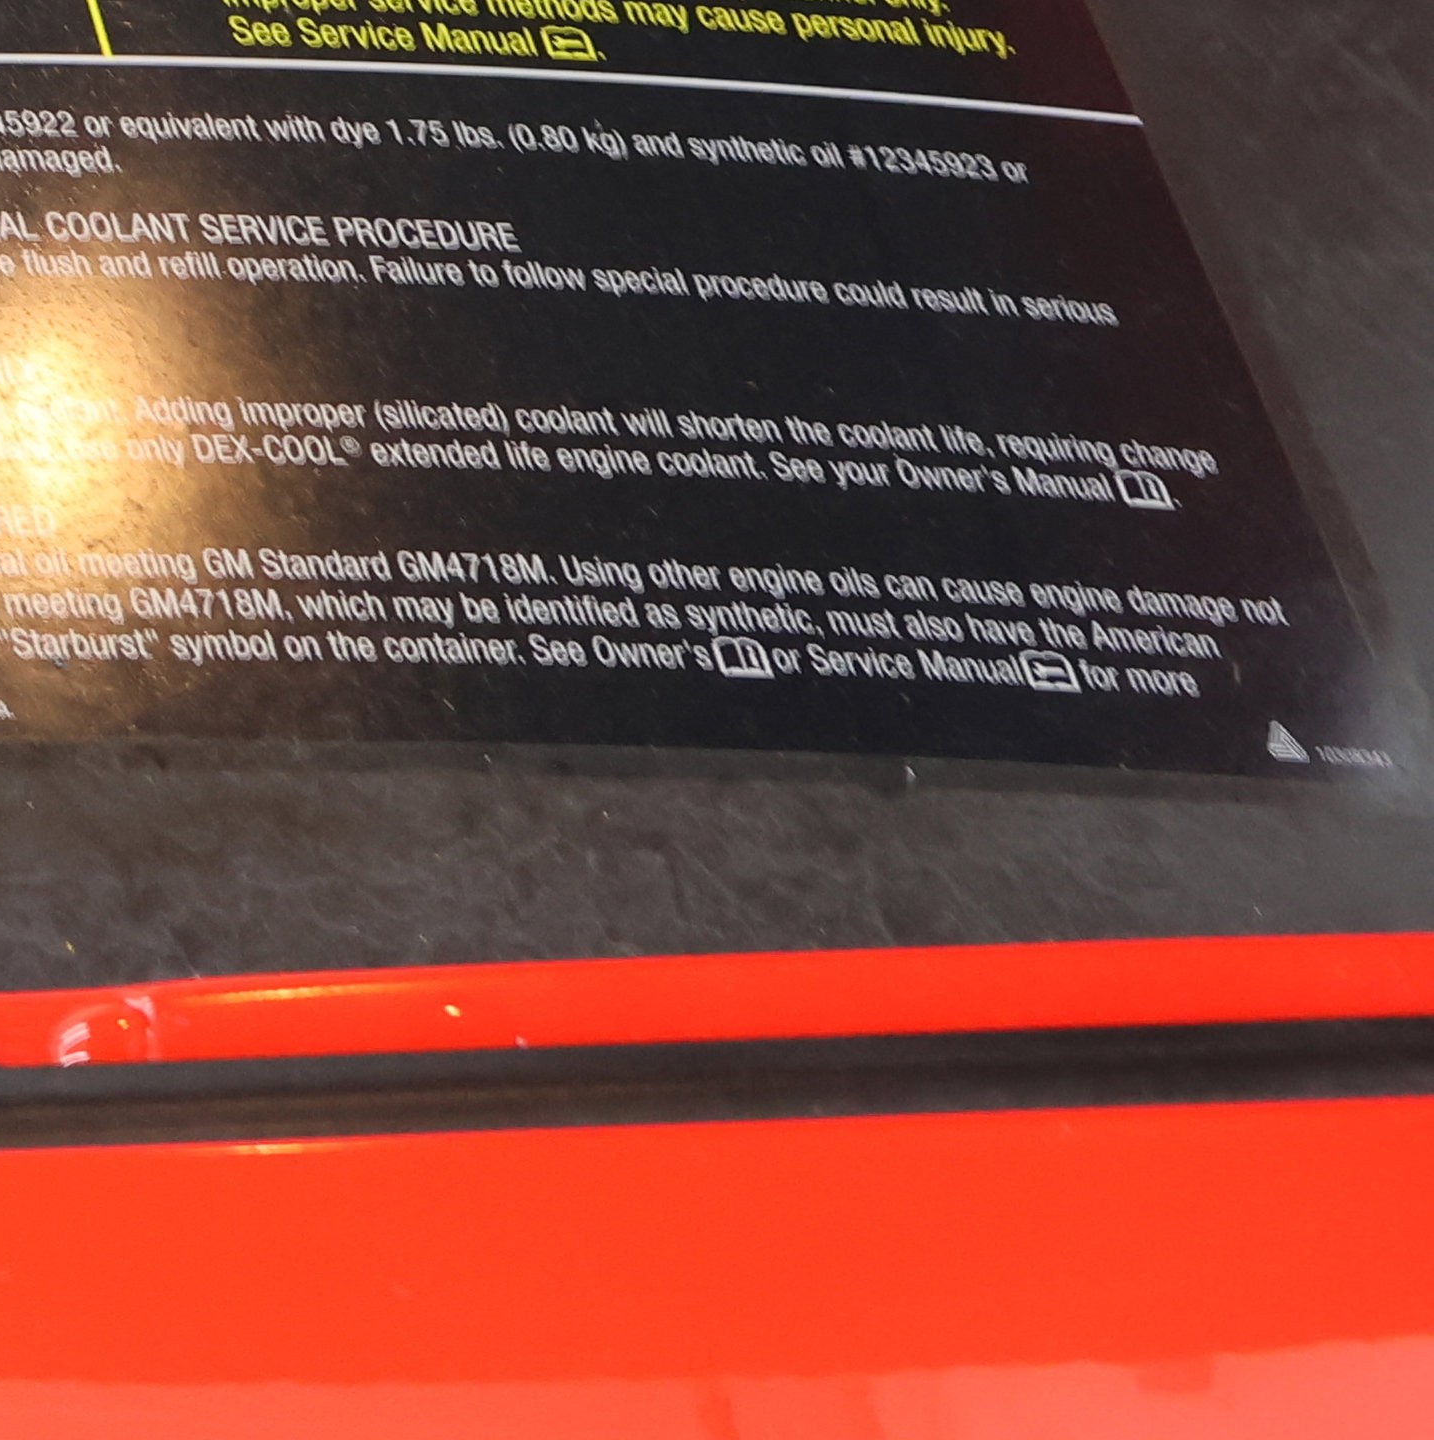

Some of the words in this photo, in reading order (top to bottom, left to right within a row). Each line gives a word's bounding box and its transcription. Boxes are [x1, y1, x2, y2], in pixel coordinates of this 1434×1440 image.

[227, 14, 292, 46] See
[295, 16, 416, 51] Service
[418, 21, 538, 56] Manual
[622, 0, 689, 33] may
[695, 4, 786, 34] cause
[790, 12, 921, 45] personal
[920, 17, 1016, 59] injury.
[82, 115, 113, 137] or
[118, 111, 262, 143] equivalent
[262, 113, 326, 142] with
[329, 115, 381, 149] dye
[385, 118, 449, 147] 1.75
[451, 120, 504, 149] lbs.
[507, 122, 579, 153] (0.80
[580, 126, 628, 159] kg)
[631, 131, 684, 158] and
[686, 135, 807, 166] synthetic
[809, 141, 845, 168] oil
[847, 144, 998, 180] #12345923
[1000, 160, 1028, 183] or
[44, 210, 189, 244] COOLANT
[198, 212, 330, 246] SERVICE
[331, 215, 521, 252] PROCEDURE
[169, 628, 278, 666] symbol
[282, 634, 323, 661] on
[325, 629, 377, 661] the
[382, 631, 526, 665] container.
[527, 632, 588, 666] See
[591, 634, 713, 670] Owner's
[771, 647, 801, 673] or
[805, 642, 915, 679] Service
[916, 648, 1025, 684] Manual
[1078, 658, 1120, 691] for
[1124, 667, 1199, 697] more
